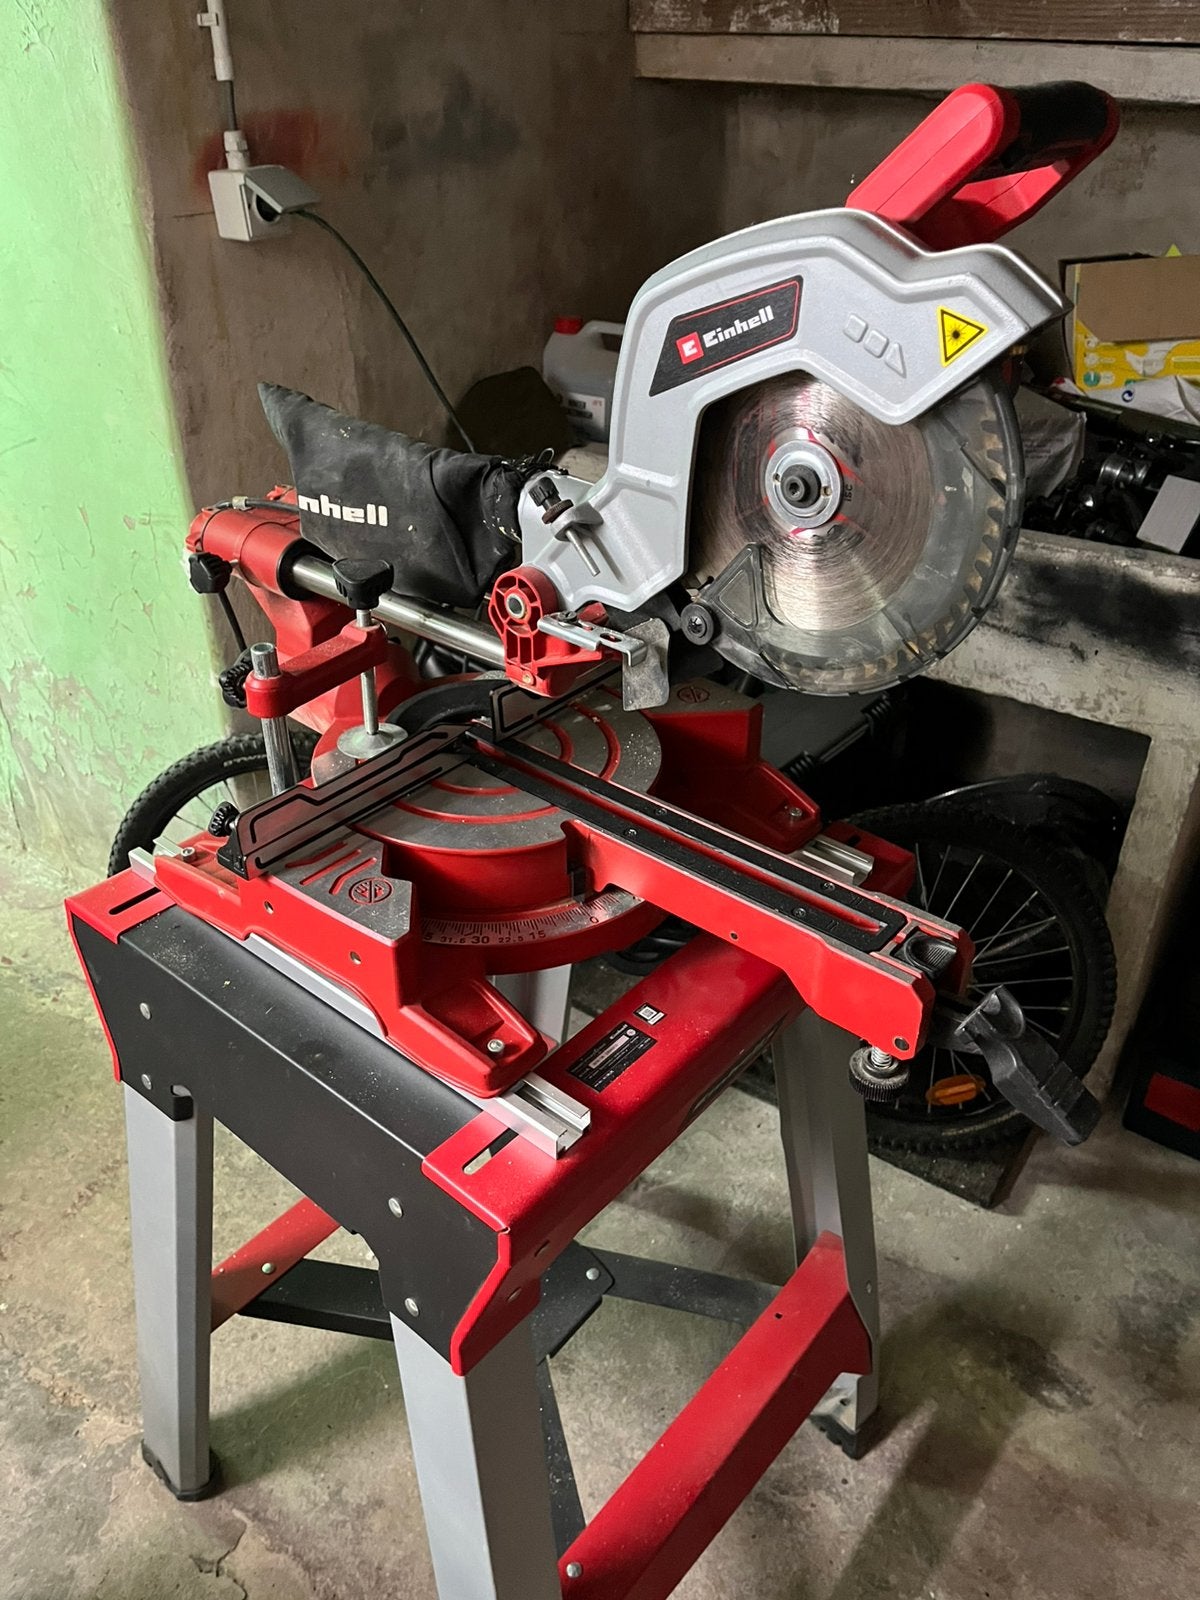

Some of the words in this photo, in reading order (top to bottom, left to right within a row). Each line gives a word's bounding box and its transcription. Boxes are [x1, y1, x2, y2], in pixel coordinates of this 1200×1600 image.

[702, 305, 775, 348] Einhell
[298, 494, 388, 527] nhell
[440, 935, 466, 944] 31.6
[471, 935, 490, 944] 30
[498, 935, 524, 944] 22.5
[529, 929, 546, 940] 15
[589, 915, 600, 924] 0
